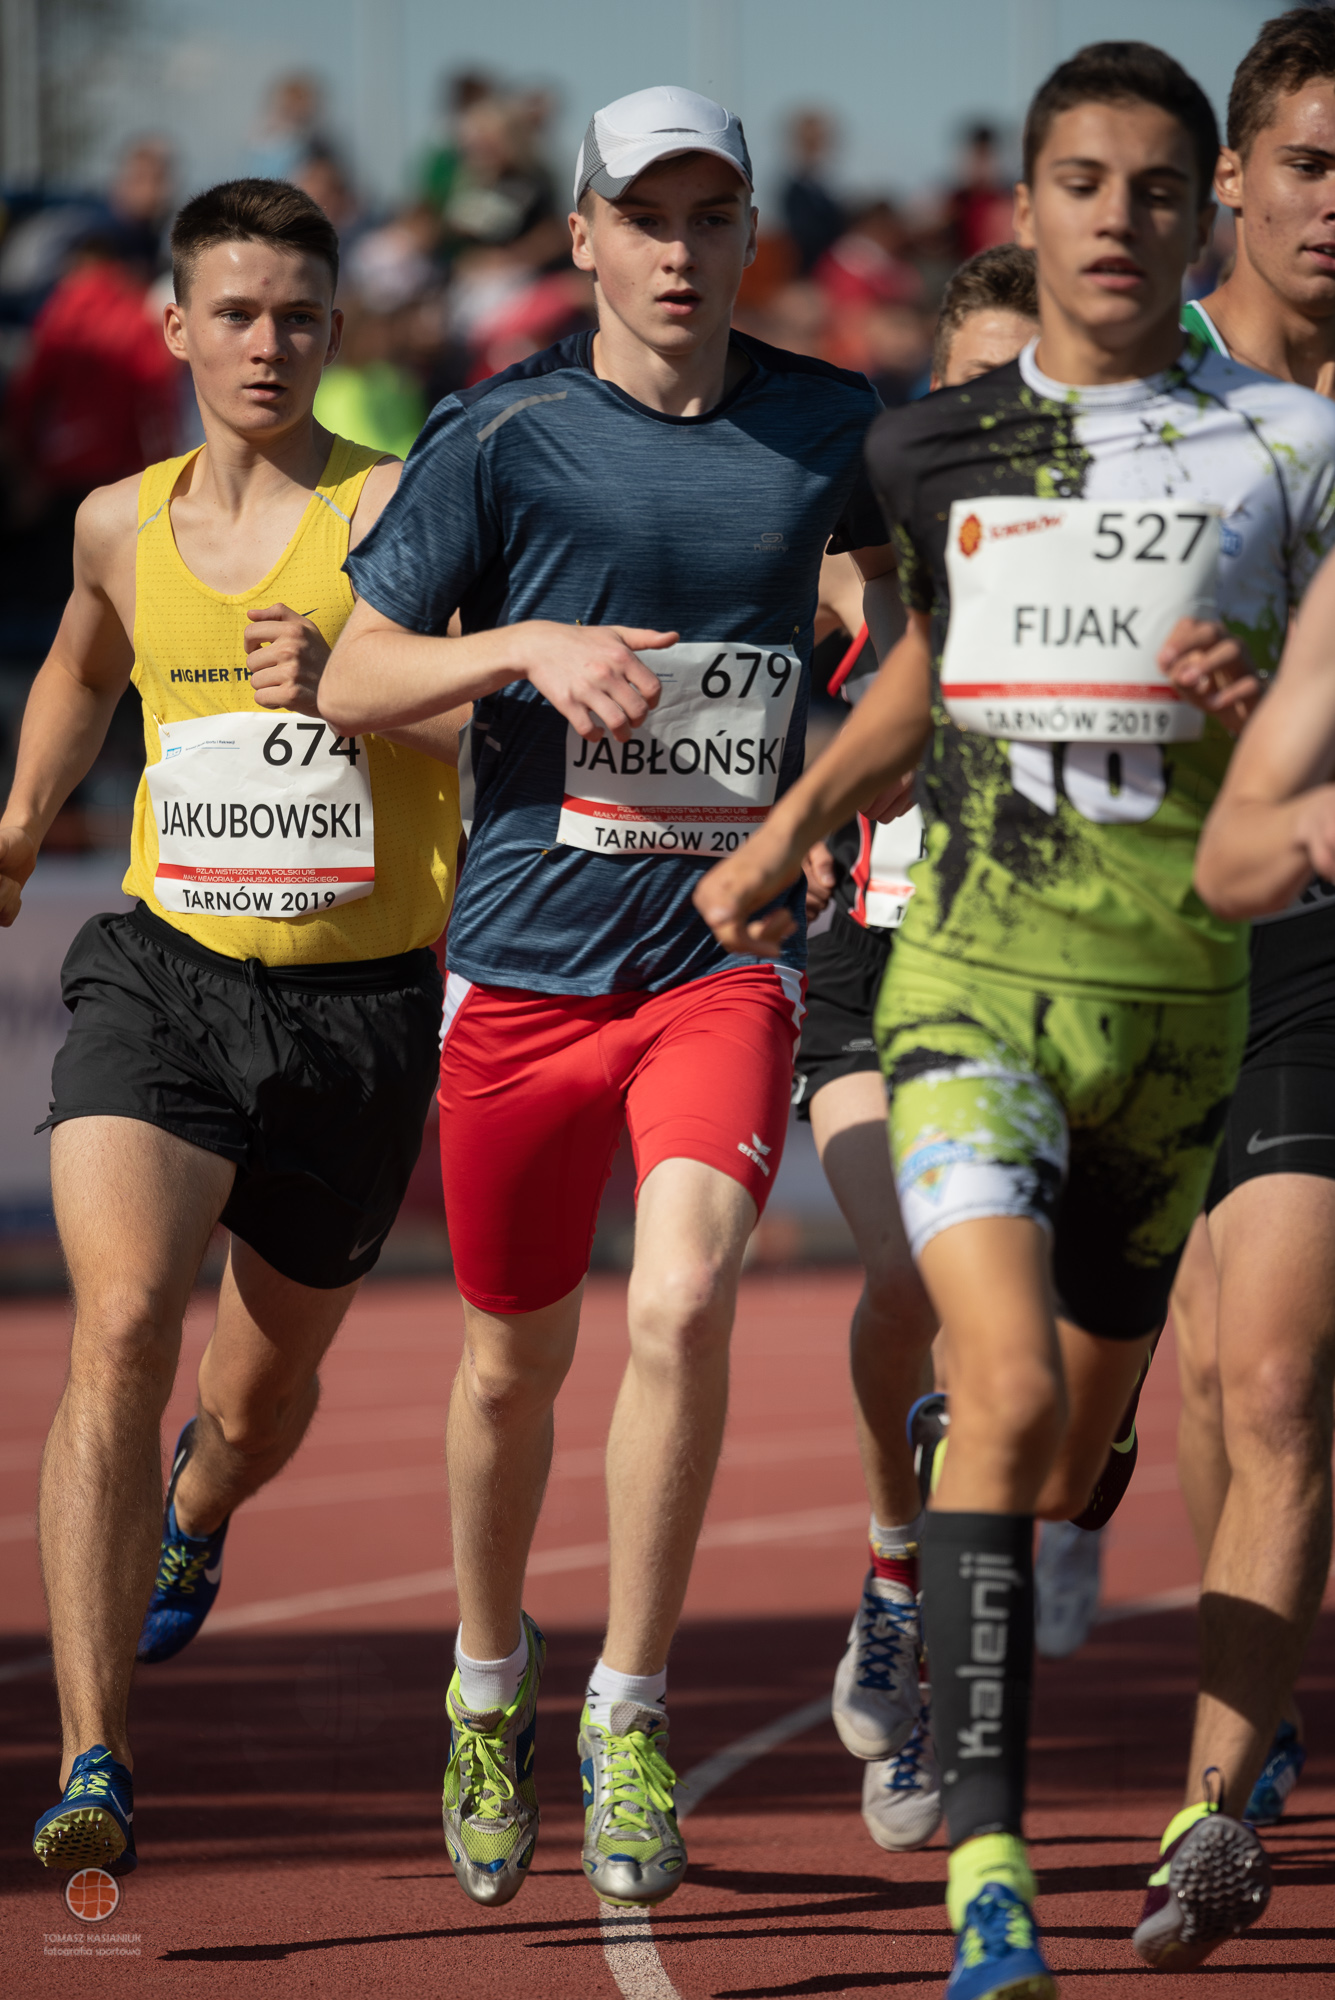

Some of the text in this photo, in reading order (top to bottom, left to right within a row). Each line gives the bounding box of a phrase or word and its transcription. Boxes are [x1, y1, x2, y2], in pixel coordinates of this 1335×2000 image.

[1093, 513, 1209, 562] 527
[1013, 606, 1140, 647] FIJAK
[170, 667, 254, 683] HIGHER TH
[701, 652, 792, 699] 679
[984, 703, 1170, 734] TARNÓW 2019
[262, 722, 361, 767] 674
[161, 801, 361, 839] JAKUBOWSKI
[664, 814, 704, 822] JANUSZA
[595, 825, 750, 852] TARNÓW 20
[198, 875, 235, 883] MEMORIAŁ
[274, 875, 339, 883] KUSOCIŃSKIEGO
[214, 868, 271, 876] MISTRZOSTWA
[301, 868, 316, 876] U16
[182, 886, 336, 911] TARNÓW 2019
[955, 1552, 1023, 1759] kalenji
